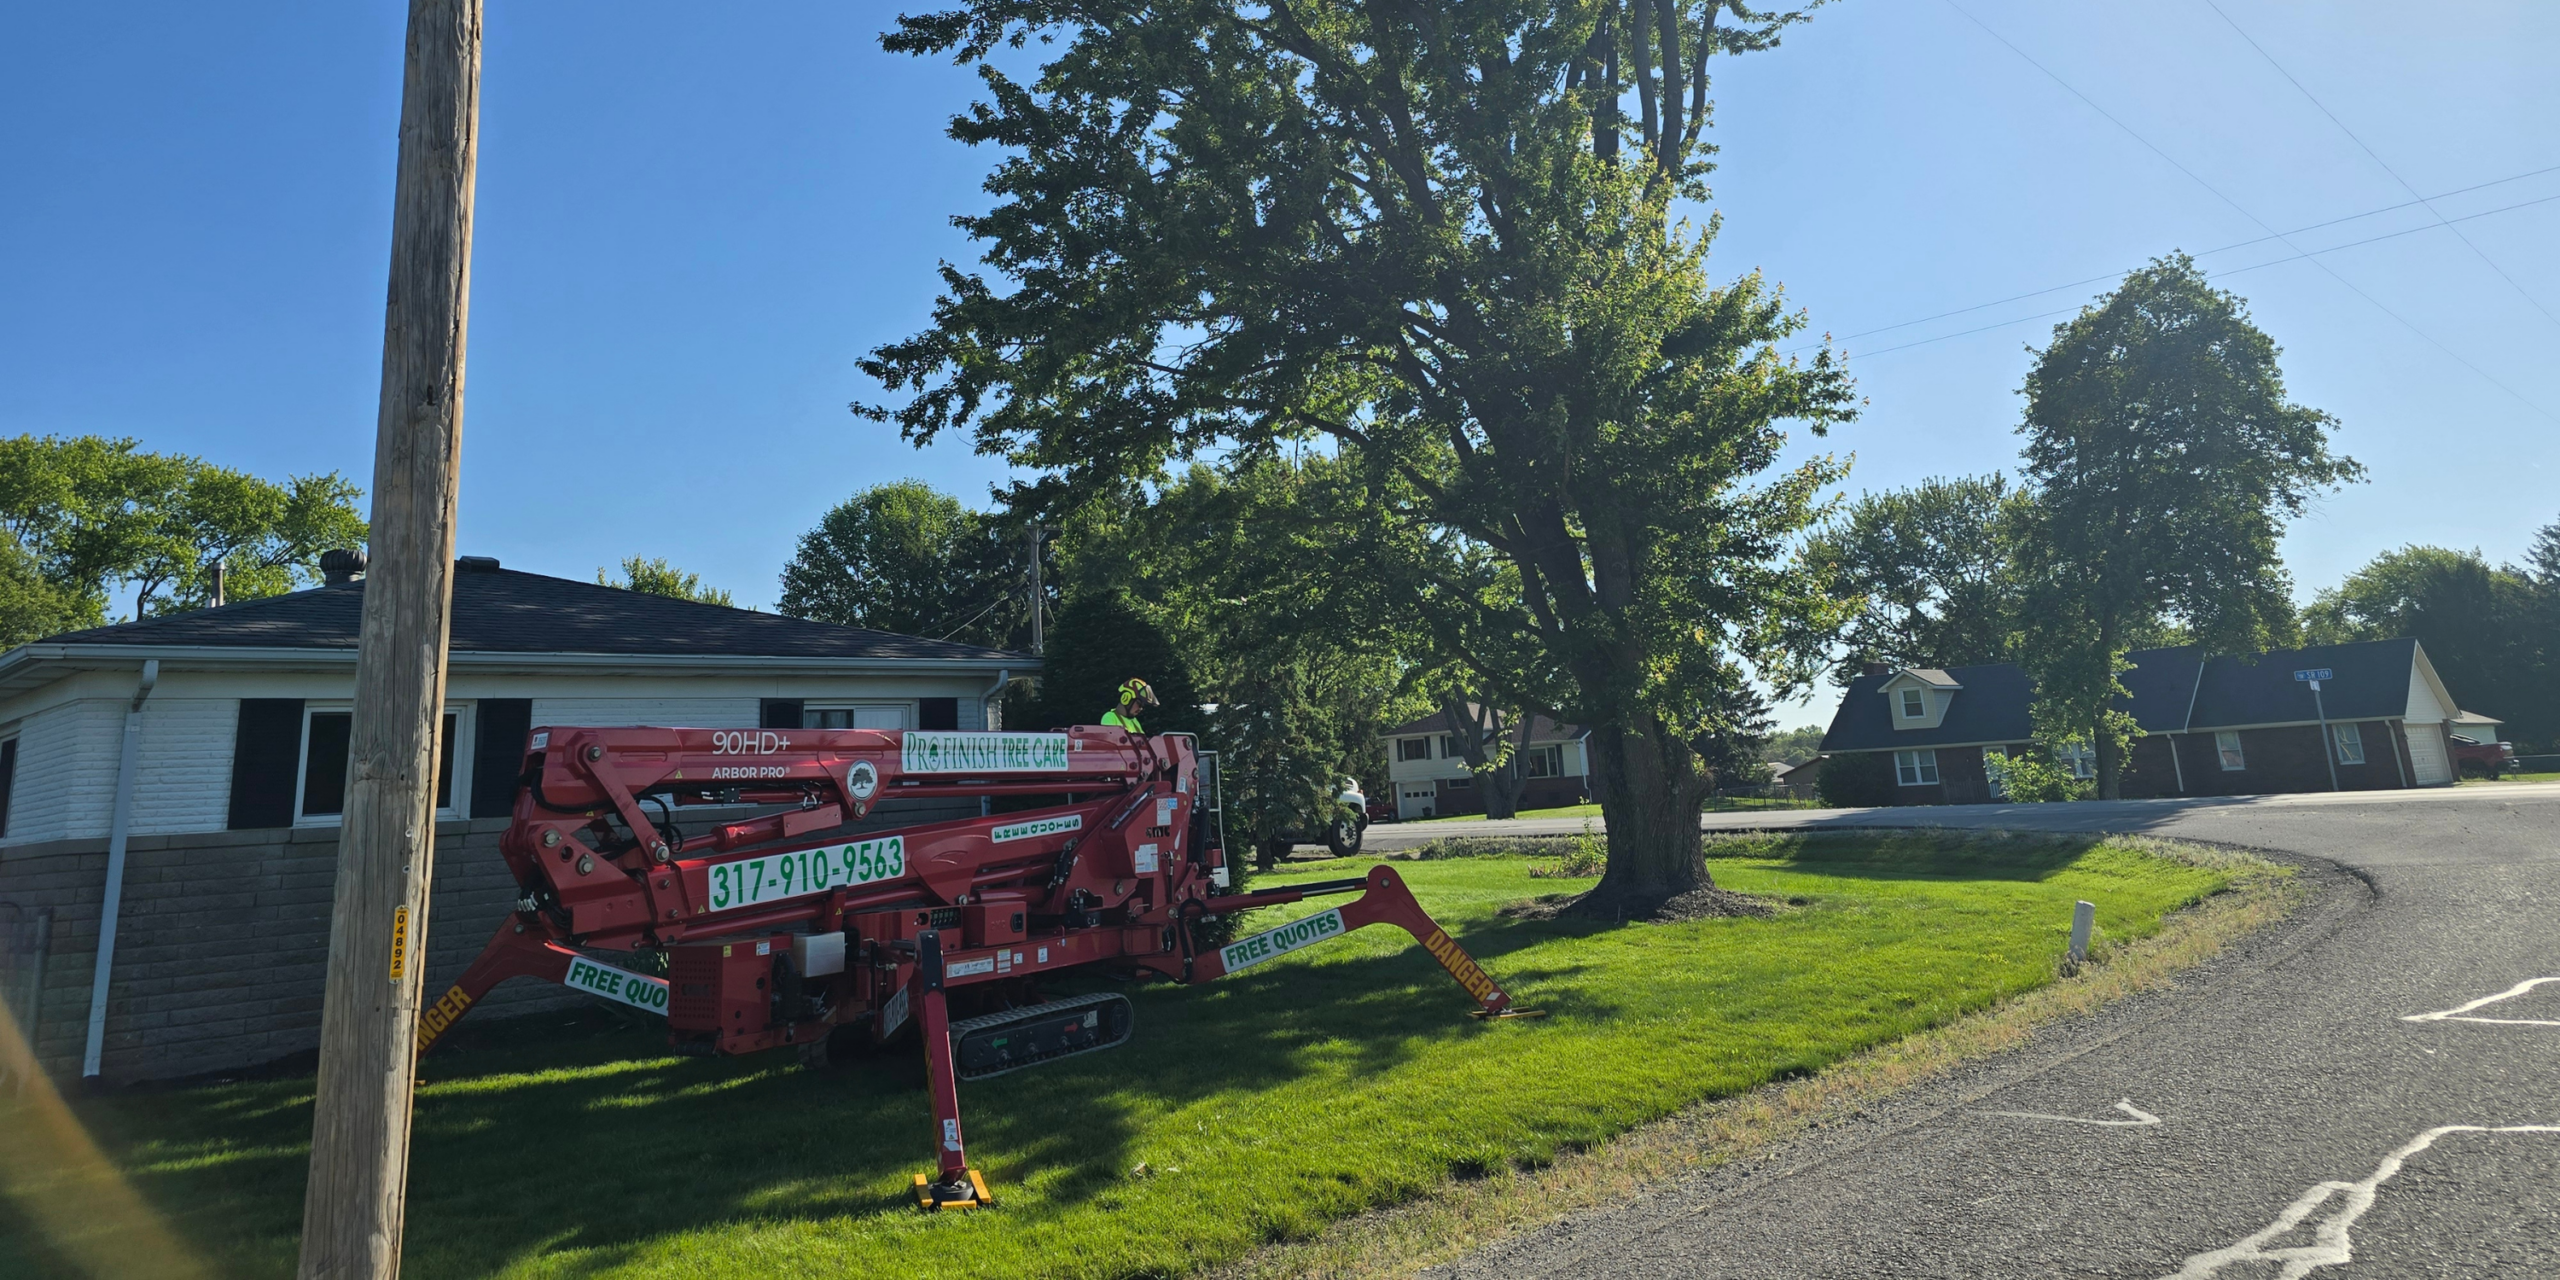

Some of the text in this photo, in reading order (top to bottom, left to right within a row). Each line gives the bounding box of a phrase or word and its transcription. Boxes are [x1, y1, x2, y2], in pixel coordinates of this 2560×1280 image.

[2306, 671, 2316, 679] SR
[2317, 670, 2329, 679] 109
[712, 731, 791, 755] 90HD+
[1002, 738, 1029, 767] TREE
[1033, 737, 1066, 767] CARE
[712, 767, 757, 779] ARBOR
[994, 818, 1079, 839] FREE QUOTES
[713, 838, 902, 908] 317-910-9563
[393, 914, 405, 970] 04892
[1225, 913, 1339, 967] FREE QUOTES
[569, 961, 668, 1011] FREE QUO
[1424, 929, 1494, 1002] DANGER
[417, 985, 472, 1051] NGER
